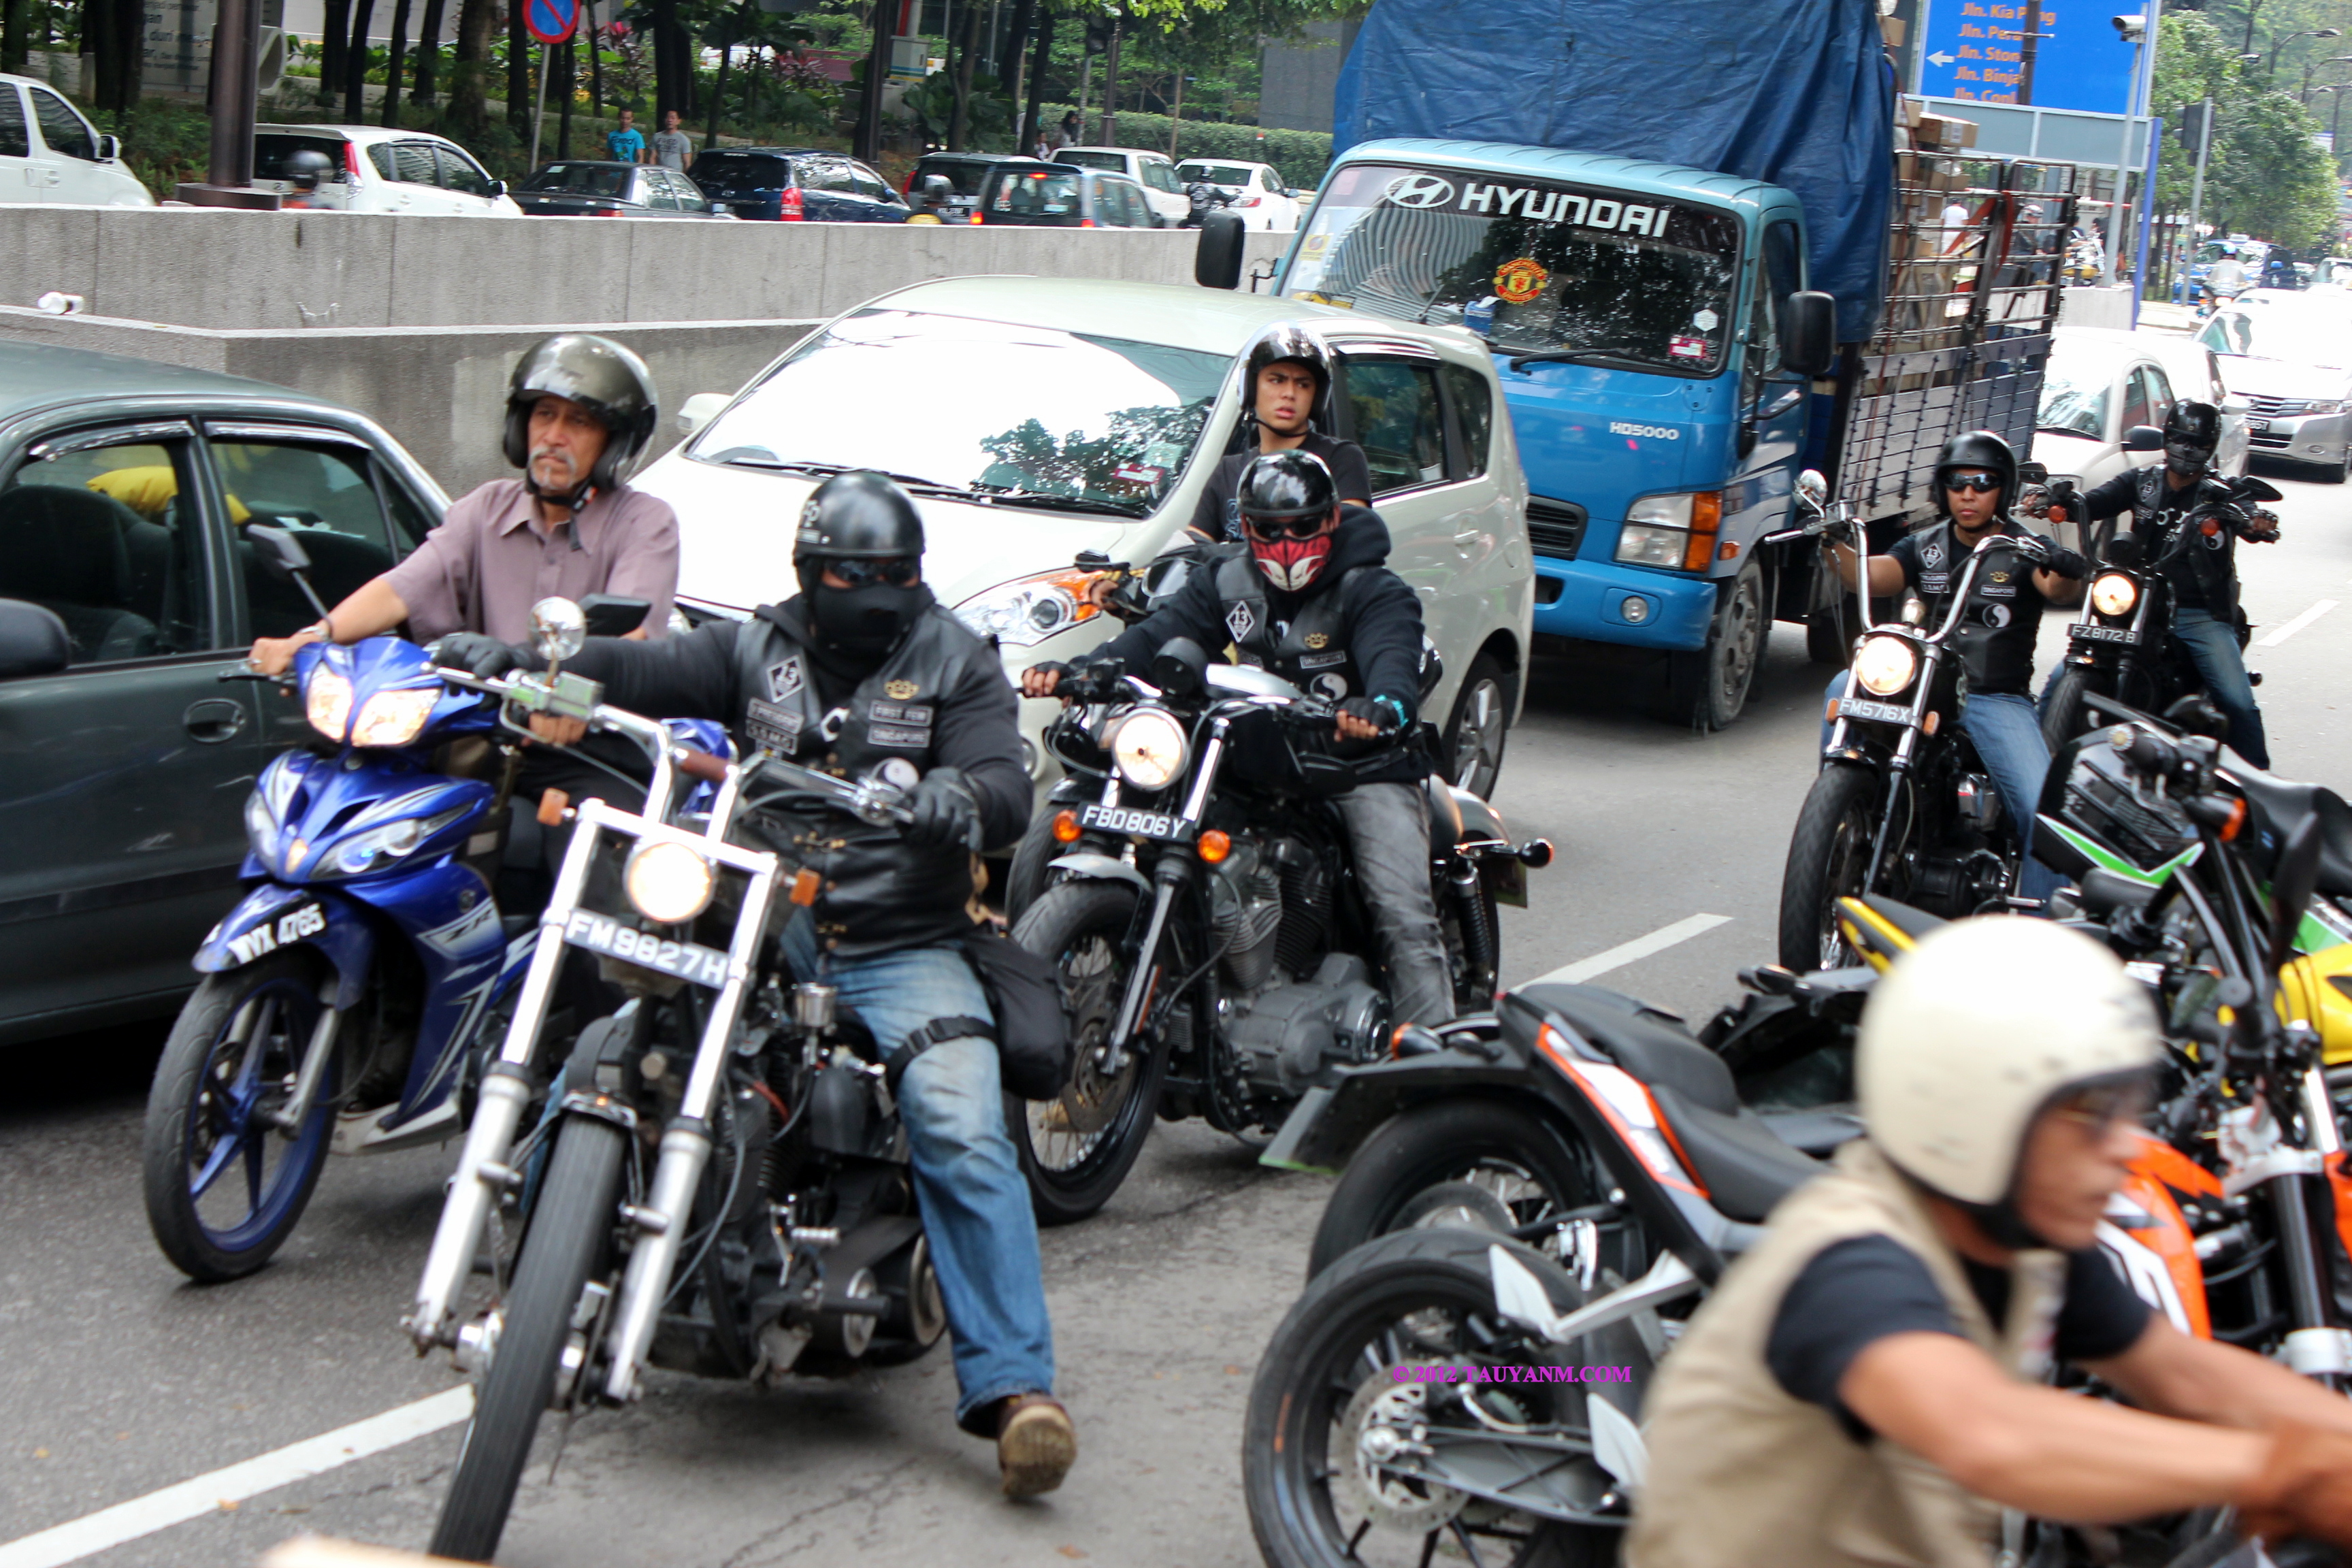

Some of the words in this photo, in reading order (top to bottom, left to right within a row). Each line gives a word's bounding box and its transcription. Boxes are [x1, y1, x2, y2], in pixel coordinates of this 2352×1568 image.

[1961, 3, 1987, 16] Jln.
[1990, 5, 2014, 19] Kia
[2016, 6, 2057, 26] Png
[1958, 24, 1985, 38] Jln.
[1988, 26, 2024, 41] Pera
[1956, 45, 1983, 59] Jln.
[1985, 46, 2021, 62] Ston
[1954, 66, 1980, 80] Jln.
[1983, 68, 2021, 87] Binja
[1981, 90, 2018, 104] Conl
[1458, 182, 1671, 238] HYUNDAI
[1610, 422, 1680, 440] HD5000
[1927, 548, 1939, 557] 13
[1234, 610, 1248, 625] 13
[1839, 699, 1910, 722] FM5716X
[1081, 805, 1187, 838] FBD806Y
[278, 902, 327, 945] 4765
[566, 913, 728, 985] FM9827H
